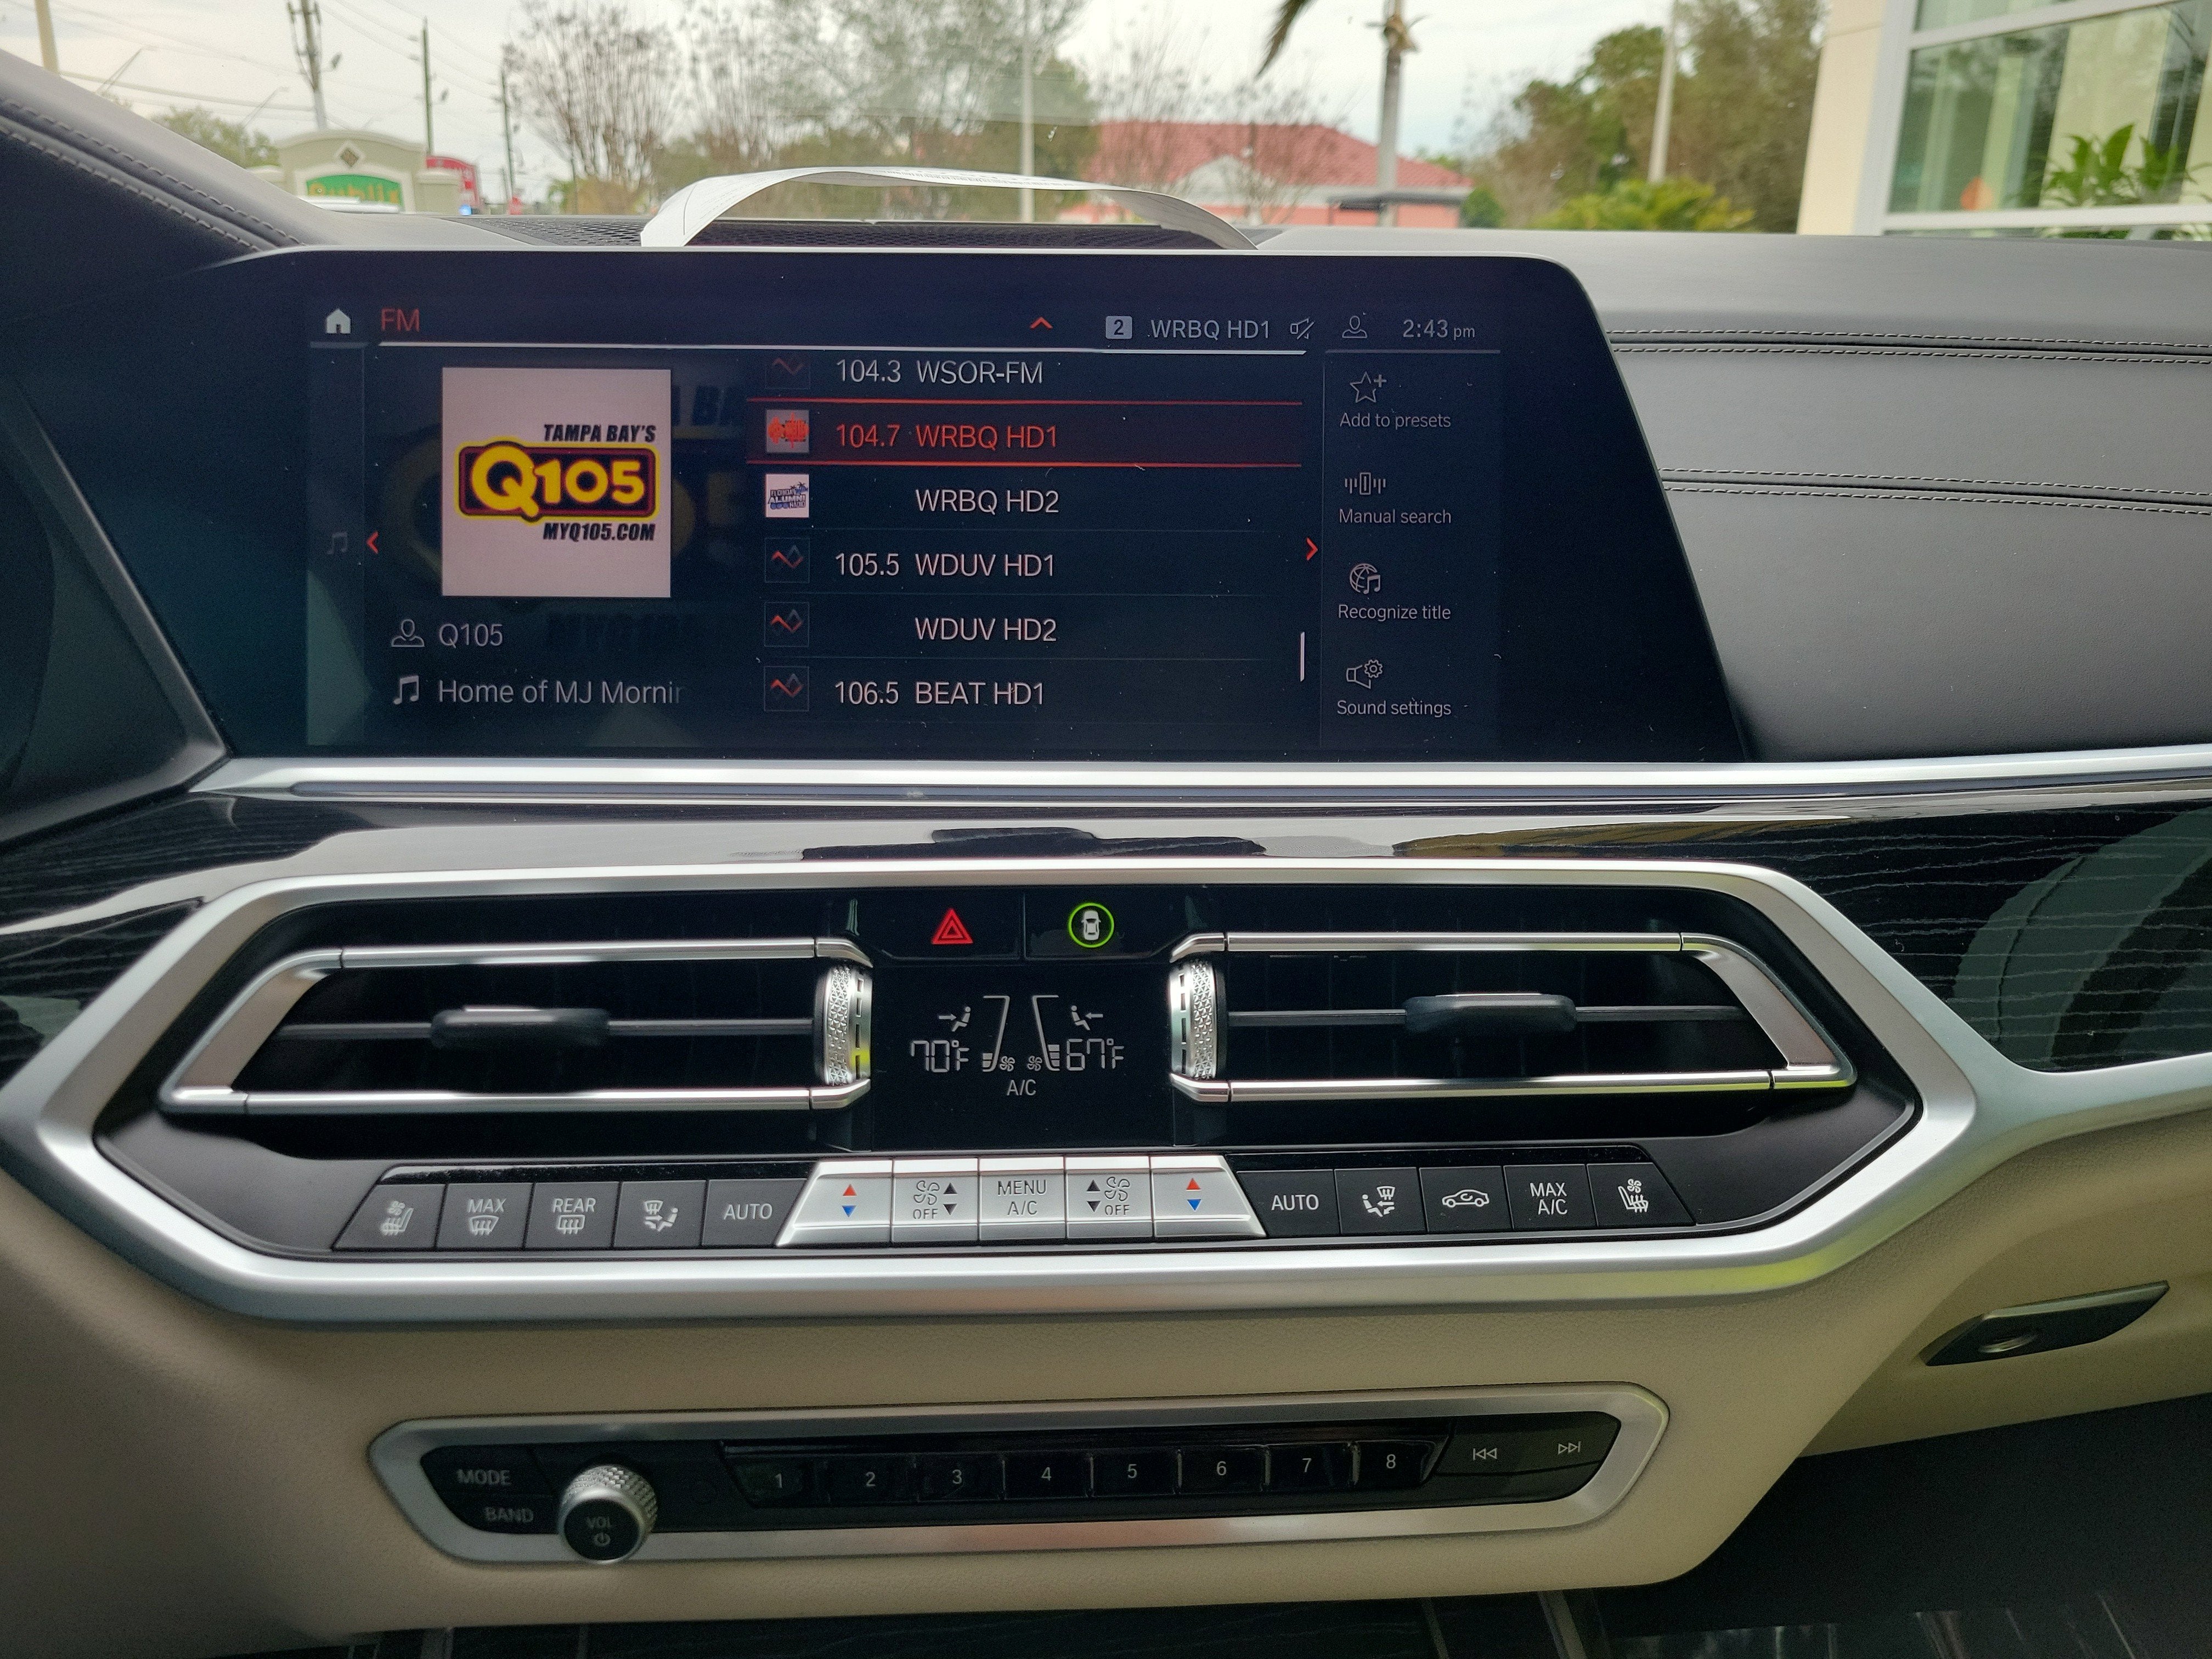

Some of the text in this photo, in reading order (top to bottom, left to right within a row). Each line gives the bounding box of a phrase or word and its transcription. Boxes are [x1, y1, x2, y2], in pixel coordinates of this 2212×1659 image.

[380, 308, 420, 332] FM
[1113, 319, 1124, 335] 2
[1150, 320, 1269, 341] WRBQ HD1
[1403, 320, 1476, 340] 2:43 pm
[836, 359, 1043, 384] 104.3 WSOR-FM
[1340, 413, 1451, 430] Add to presets
[544, 425, 657, 442] TAMPA BAY'S
[837, 424, 1057, 450] 104.7 WRBQ HD1
[471, 445, 645, 517] Q105
[916, 489, 1059, 514] WRBQ HD2
[1339, 509, 1452, 524] Manual search
[543, 522, 656, 541] MYQ105.COM
[836, 554, 1054, 577] 105.5 WDUV HD1
[1338, 604, 1451, 622] Recognize title
[438, 624, 504, 648] Q105
[916, 618, 1057, 641] WDUV HD2
[439, 680, 514, 703] Home
[523, 681, 548, 703] of
[556, 682, 592, 703] MJ
[835, 681, 1043, 704] 106.5 BEAT HD1
[1337, 700, 1452, 717] Sound settings
[1007, 1079, 1036, 1096] A/C
[997, 1180, 1046, 1195] MENU
[1530, 1182, 1567, 1197] MAX
[467, 1198, 505, 1214] MAX
[552, 1197, 596, 1212] REAR
[1008, 1200, 1038, 1216] A/C
[1104, 1204, 1130, 1216] OFF
[1271, 1193, 1319, 1211] AUTO
[1537, 1200, 1568, 1215] A/C
[724, 1203, 772, 1221] AUTO
[912, 1207, 939, 1220] OFF
[1216, 1460, 1227, 1476] 6
[1302, 1457, 1312, 1474] 7
[1386, 1453, 1396, 1469] 8
[457, 1469, 511, 1487] MODE
[865, 1471, 876, 1487] 2
[952, 1469, 963, 1485] 3
[1041, 1467, 1052, 1481] 4
[1127, 1464, 1137, 1479] 5
[775, 1473, 783, 1488] 1
[484, 1507, 534, 1523] BAND
[586, 1517, 612, 1528] VOL
